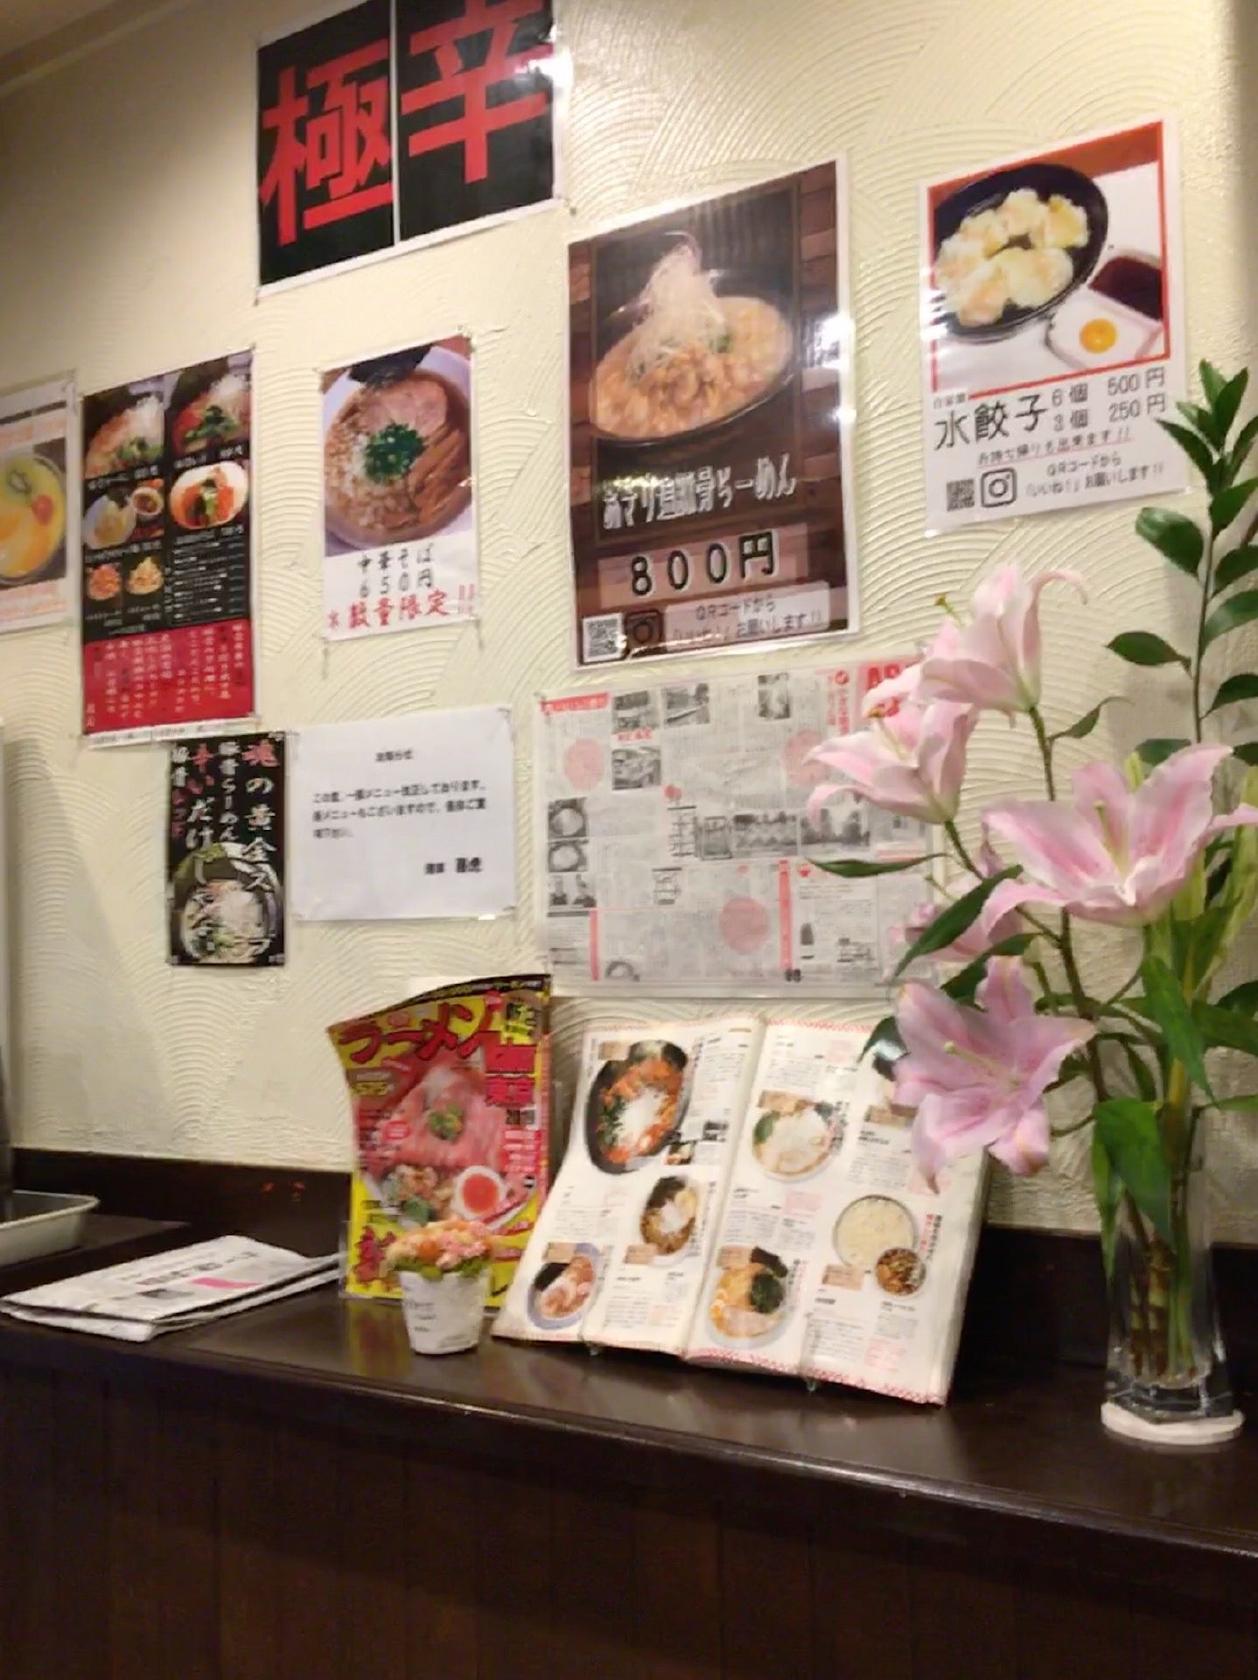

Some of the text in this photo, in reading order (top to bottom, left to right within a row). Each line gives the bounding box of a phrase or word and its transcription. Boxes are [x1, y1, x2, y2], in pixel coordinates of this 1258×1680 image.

[258, 0, 553, 247] 極辛
[1107, 367, 1165, 396] 500円
[934, 394, 1049, 450] 水餃子
[1108, 393, 1166, 422] 250円
[358, 542, 435, 573] 中華そば
[630, 529, 777, 597] 800円
[359, 568, 434, 598] 650円
[337, 1000, 493, 1065] ラーメン
